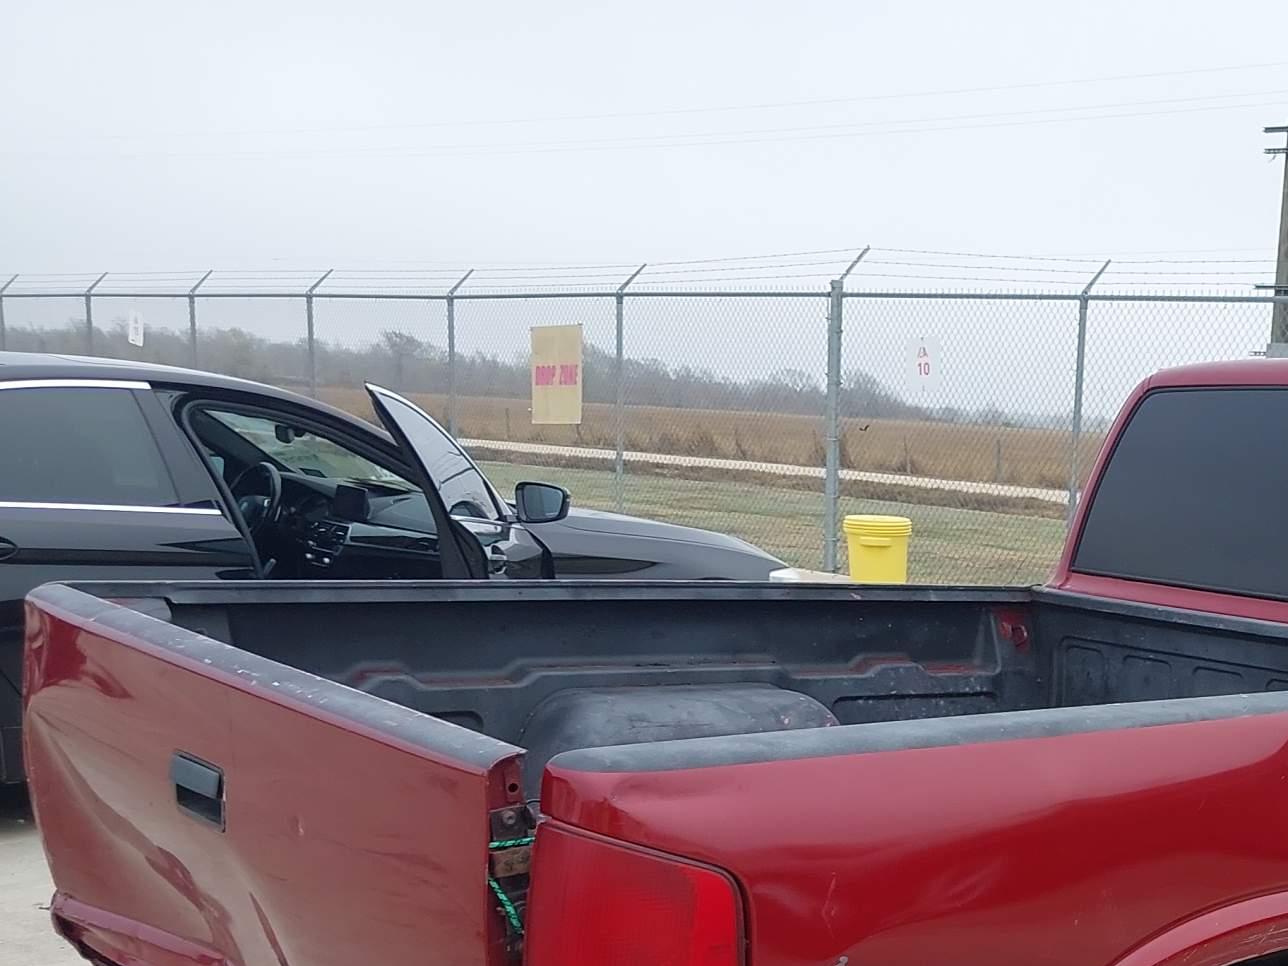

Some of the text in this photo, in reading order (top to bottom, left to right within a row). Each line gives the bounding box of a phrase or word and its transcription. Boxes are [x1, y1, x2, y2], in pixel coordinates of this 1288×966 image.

[535, 363, 579, 386] DROP ZONE
[918, 362, 930, 376] 10
